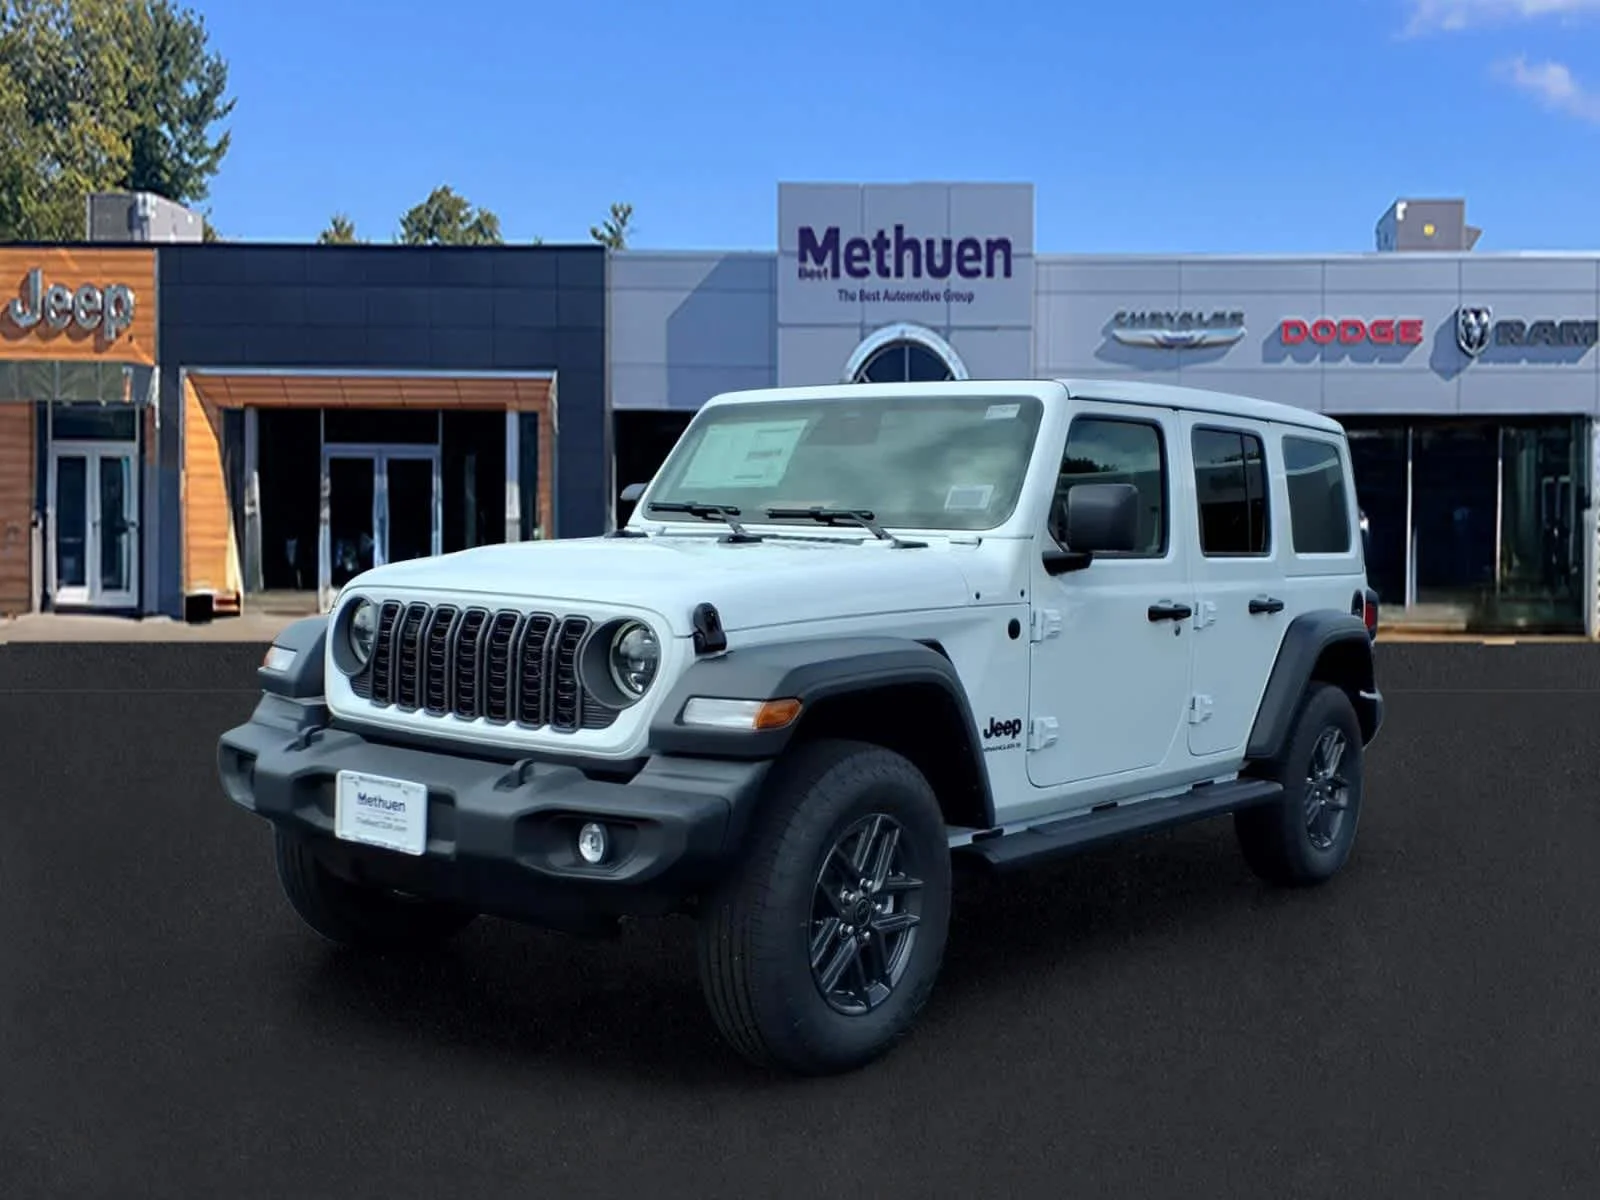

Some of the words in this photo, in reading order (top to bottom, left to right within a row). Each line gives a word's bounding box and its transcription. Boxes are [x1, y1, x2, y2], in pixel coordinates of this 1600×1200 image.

[798, 224, 1012, 279] Methuen
[798, 266, 828, 280] Best
[9, 268, 135, 341] Jeep
[838, 289, 856, 302] The
[859, 289, 880, 302] Best
[883, 289, 941, 302] Automotive
[943, 289, 975, 304] Group
[1280, 319, 1424, 345] DODGE
[1495, 320, 1599, 346] RAM
[983, 717, 1022, 739] Jeep
[357, 792, 406, 812] Methuen
